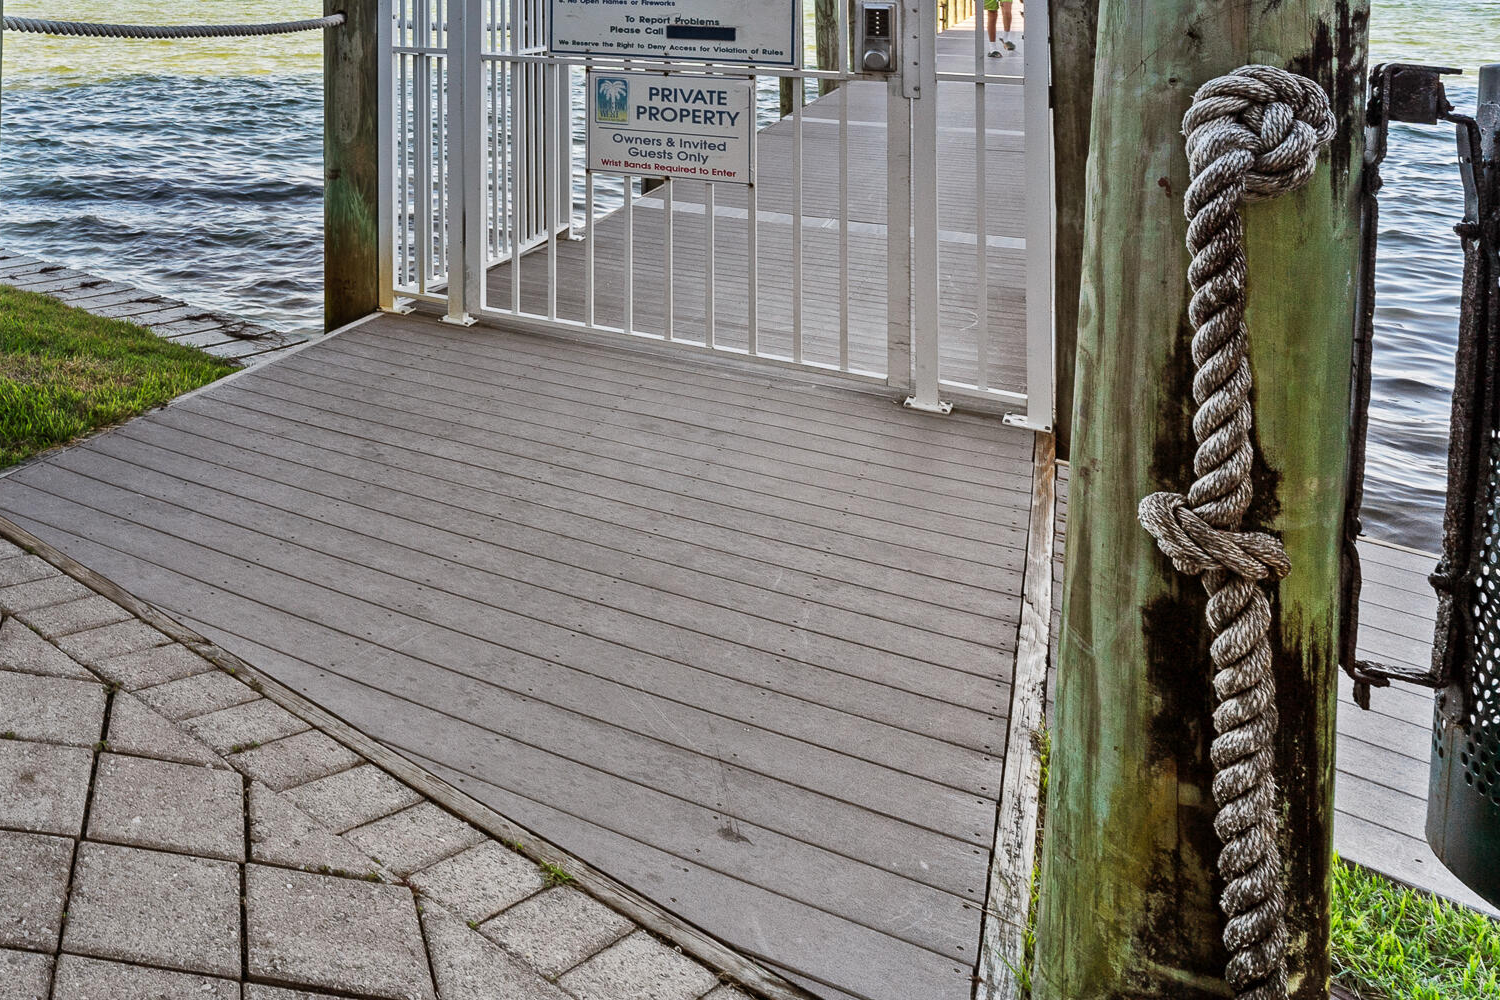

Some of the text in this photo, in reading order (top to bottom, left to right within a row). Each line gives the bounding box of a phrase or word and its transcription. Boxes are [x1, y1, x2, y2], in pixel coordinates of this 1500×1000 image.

[639, 16, 670, 25] Report
[675, 17, 720, 26] Problems
[610, 26, 664, 35] Please Call
[617, 41, 634, 49] Right
[649, 86, 727, 106] PRIVATE
[636, 105, 740, 126] PROPERTY
[612, 133, 726, 151] Owners & Invited
[628, 147, 709, 165] Guests Only
[600, 158, 737, 178] Wrist Bands Required to Enter
